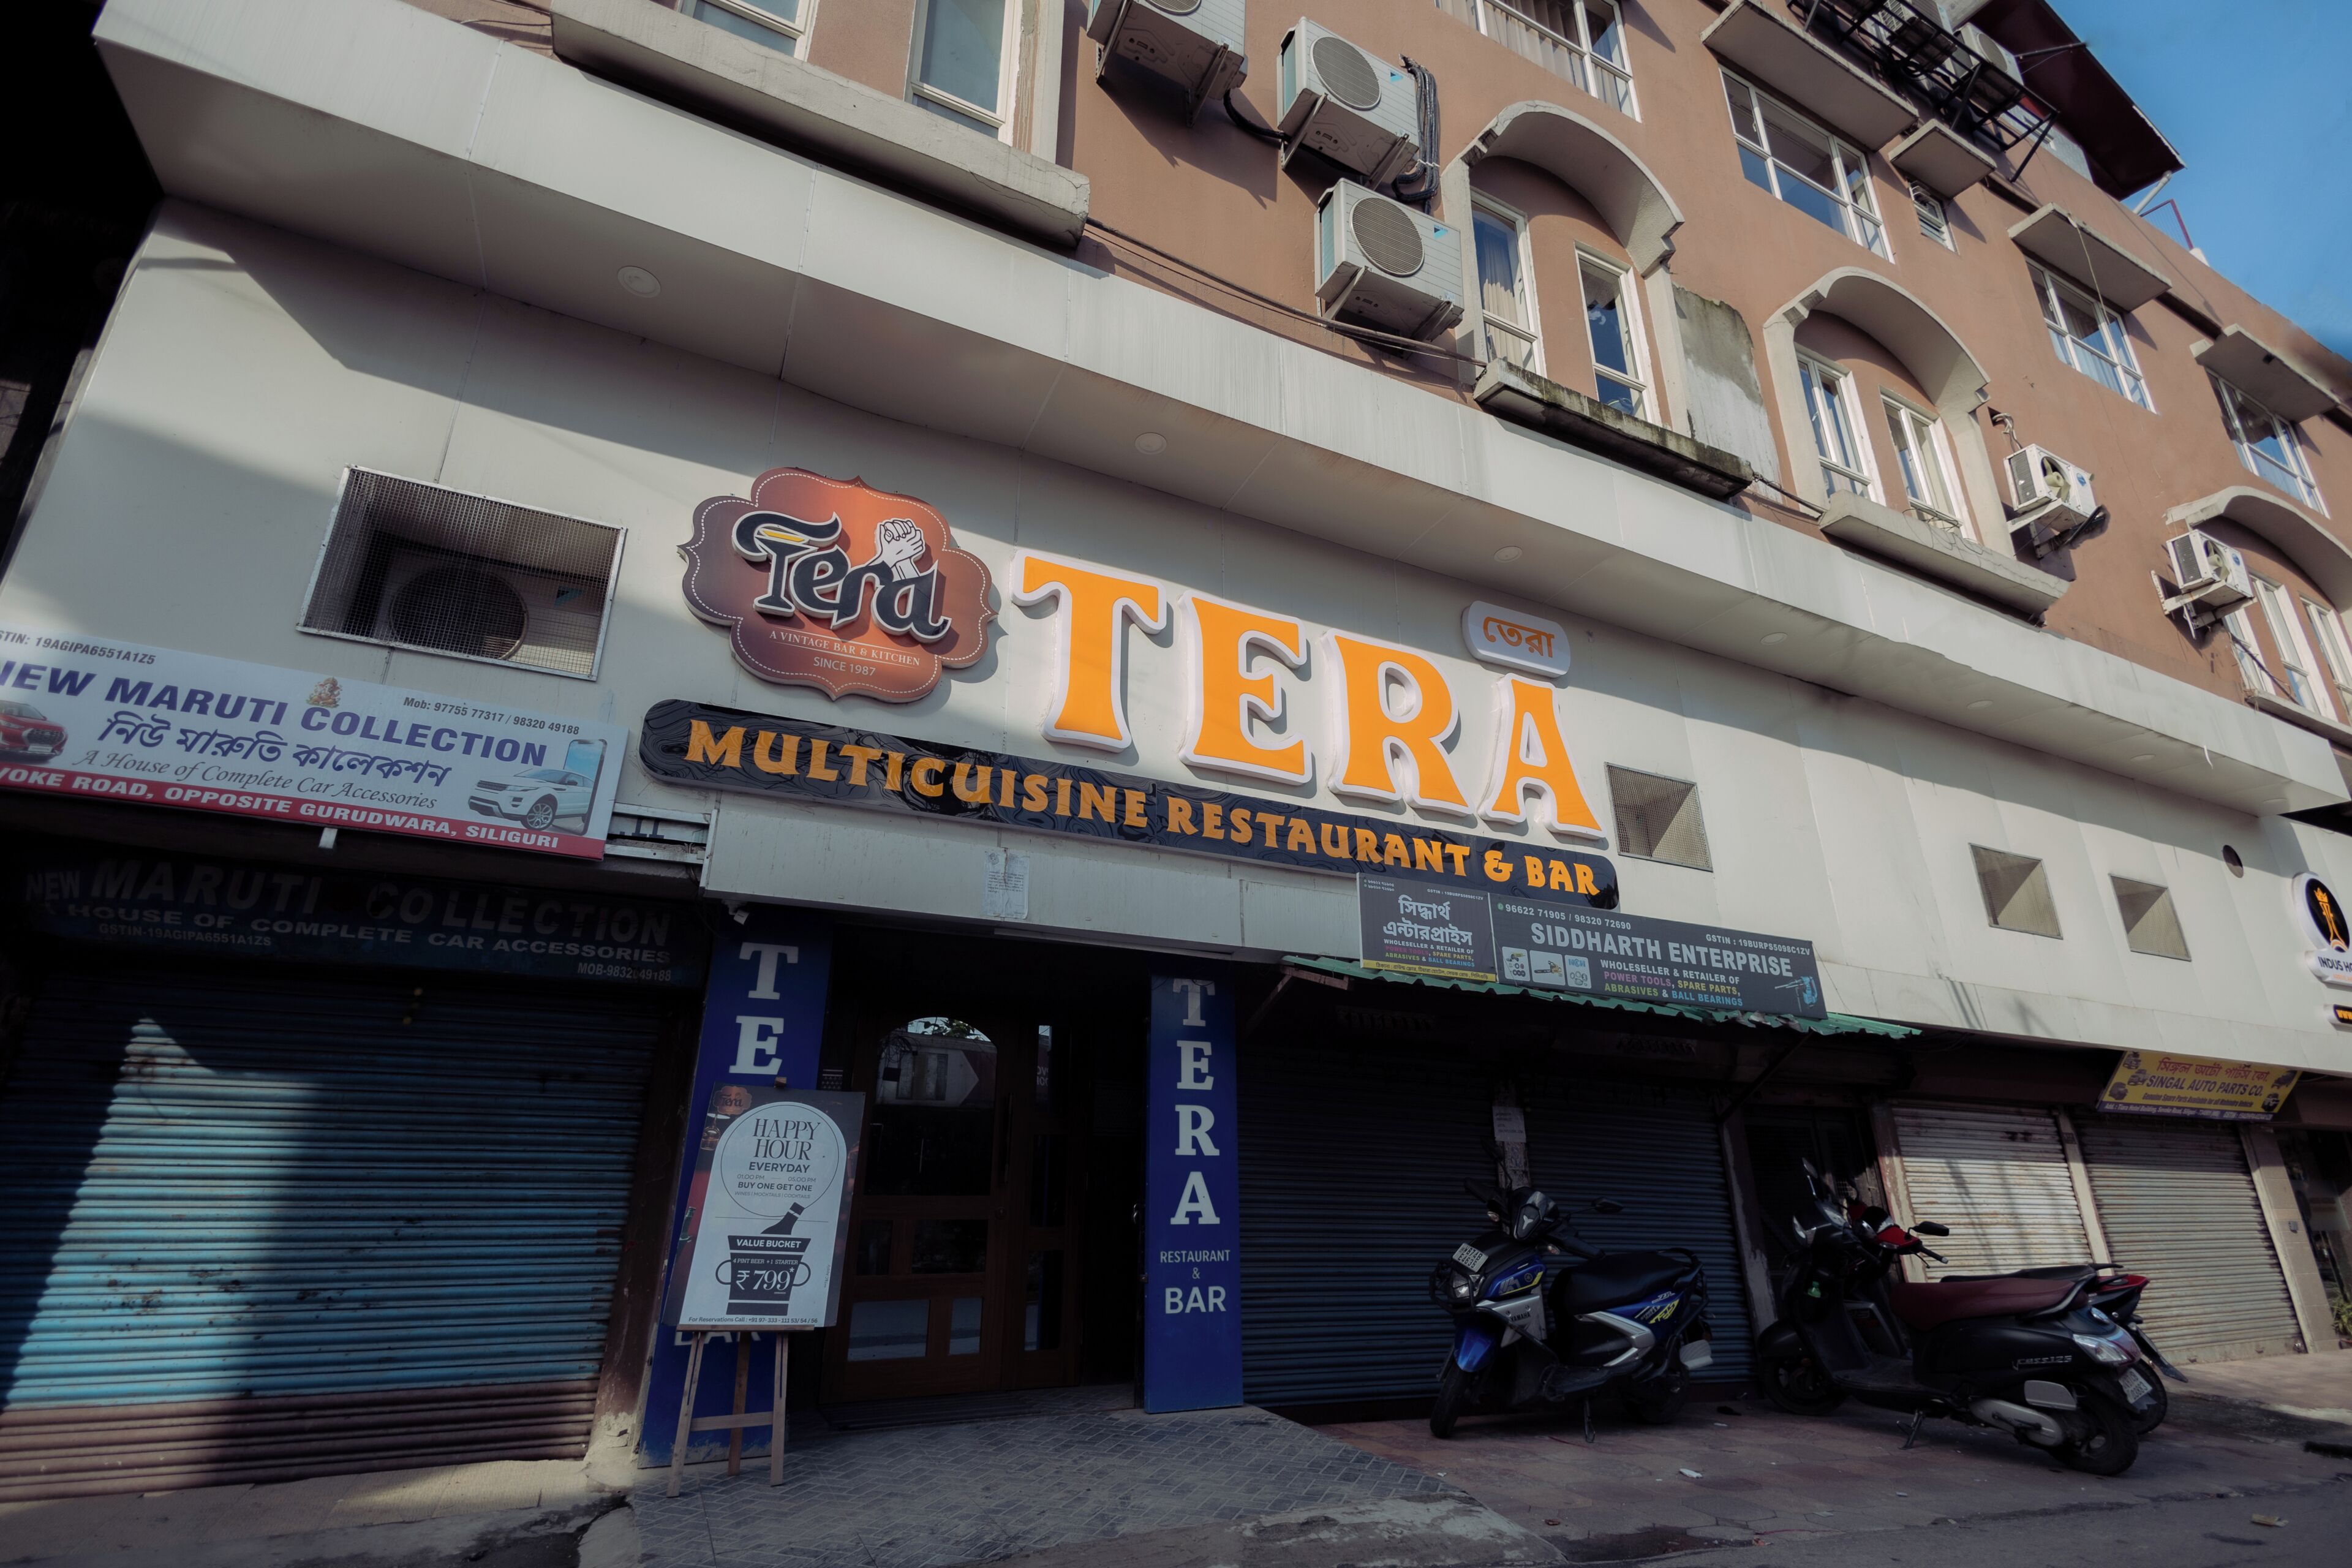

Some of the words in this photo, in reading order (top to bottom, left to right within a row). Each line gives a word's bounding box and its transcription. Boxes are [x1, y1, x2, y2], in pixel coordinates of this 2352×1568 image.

[733, 510, 952, 643] Tera
[769, 631, 777, 639] A
[780, 631, 831, 649] VINTAGE
[834, 643, 856, 655] BAR
[859, 647, 868, 657] &
[871, 649, 920, 666] KITCHEN
[1482, 616, 1555, 658] তেরা
[813, 657, 846, 672] SINCE
[850, 663, 876, 676] 1987
[1017, 552, 1605, 837] TERA
[104, 677, 288, 726] MARUTI
[301, 706, 548, 767] COLLECTION
[403, 696, 431, 710] Mob:
[434, 702, 468, 716] 97755
[472, 709, 505, 723] 77317
[513, 716, 545, 730] 98320
[548, 723, 580, 735] 49188
[97, 710, 172, 748] নিউ
[179, 729, 288, 763] মারুতি
[292, 743, 452, 788] কালেকশন
[72, 750, 97, 766] A
[99, 751, 170, 775] House
[175, 762, 199, 782] of
[202, 764, 293, 791] Complete
[298, 778, 331, 794] Car
[331, 782, 437, 810] Accessories
[72, 777, 154, 799] ROAD,
[164, 786, 293, 813] OPPOSITE
[300, 803, 458, 837] GURUDWARA,
[466, 826, 559, 849] SILIGURI
[684, 718, 1147, 829] MULTICUISINE
[1166, 796, 1471, 876] RESTAURANT
[1483, 850, 1513, 883] &
[1525, 855, 1600, 896] BAR
[25, 870, 81, 901] NEW
[91, 858, 325, 914] MARUTI
[368, 881, 671, 947] COLLECTION
[1505, 903, 1534, 916] 96622
[1537, 908, 1566, 921] 71905
[1575, 914, 1602, 926] 98320
[1605, 919, 1631, 930] 72690
[68, 903, 183, 926] HOUSE
[192, 913, 236, 929] OF
[250, 918, 413, 944] COMPLETE
[428, 932, 486, 951] CAR
[492, 938, 672, 964] ACCESSORIES
[1384, 938, 1428, 949] WHOLESELLER
[1436, 945, 1465, 954] RETAILER
[1706, 933, 1731, 944] GSTIN
[1385, 952, 1420, 961] ABRASIVES
[1531, 922, 1662, 960] SIDDHARTH
[1668, 941, 1793, 977] ENTERPRISE
[1600, 959, 1670, 976] WHOLESELLER
[1683, 970, 1726, 984] RETAILER
[1729, 976, 1740, 985] OF
[2318, 956, 2343, 971] INDUS
[1604, 971, 1638, 983] POWER
[1641, 976, 1675, 989] TOOLS,
[1677, 980, 1706, 991] SPARE
[1709, 985, 1741, 997] PARTS,
[1605, 982, 1659, 997] ABRASIVES
[1672, 990, 1695, 1001] BALL
[1698, 993, 1744, 1006] BEARINGS
[2146, 1075, 2185, 1090] SINGAL
[2187, 1079, 2216, 1093] AUTO
[2215, 1082, 2248, 1095] PARTS
[2248, 1085, 2264, 1096] CO.
[752, 1118, 821, 1140] HAPPY
[753, 1139, 812, 1161] HOUR
[748, 1161, 811, 1174] EVERYDAY
[736, 1238, 764, 1248] VALUE
[766, 1240, 802, 1249] BUCKET
[1160, 1249, 1231, 1264] RESTAURANT
[1192, 1267, 1200, 1280] &
[1165, 1286, 1227, 1314] BAR
[1510, 1311, 1531, 1322] YAMAHA
